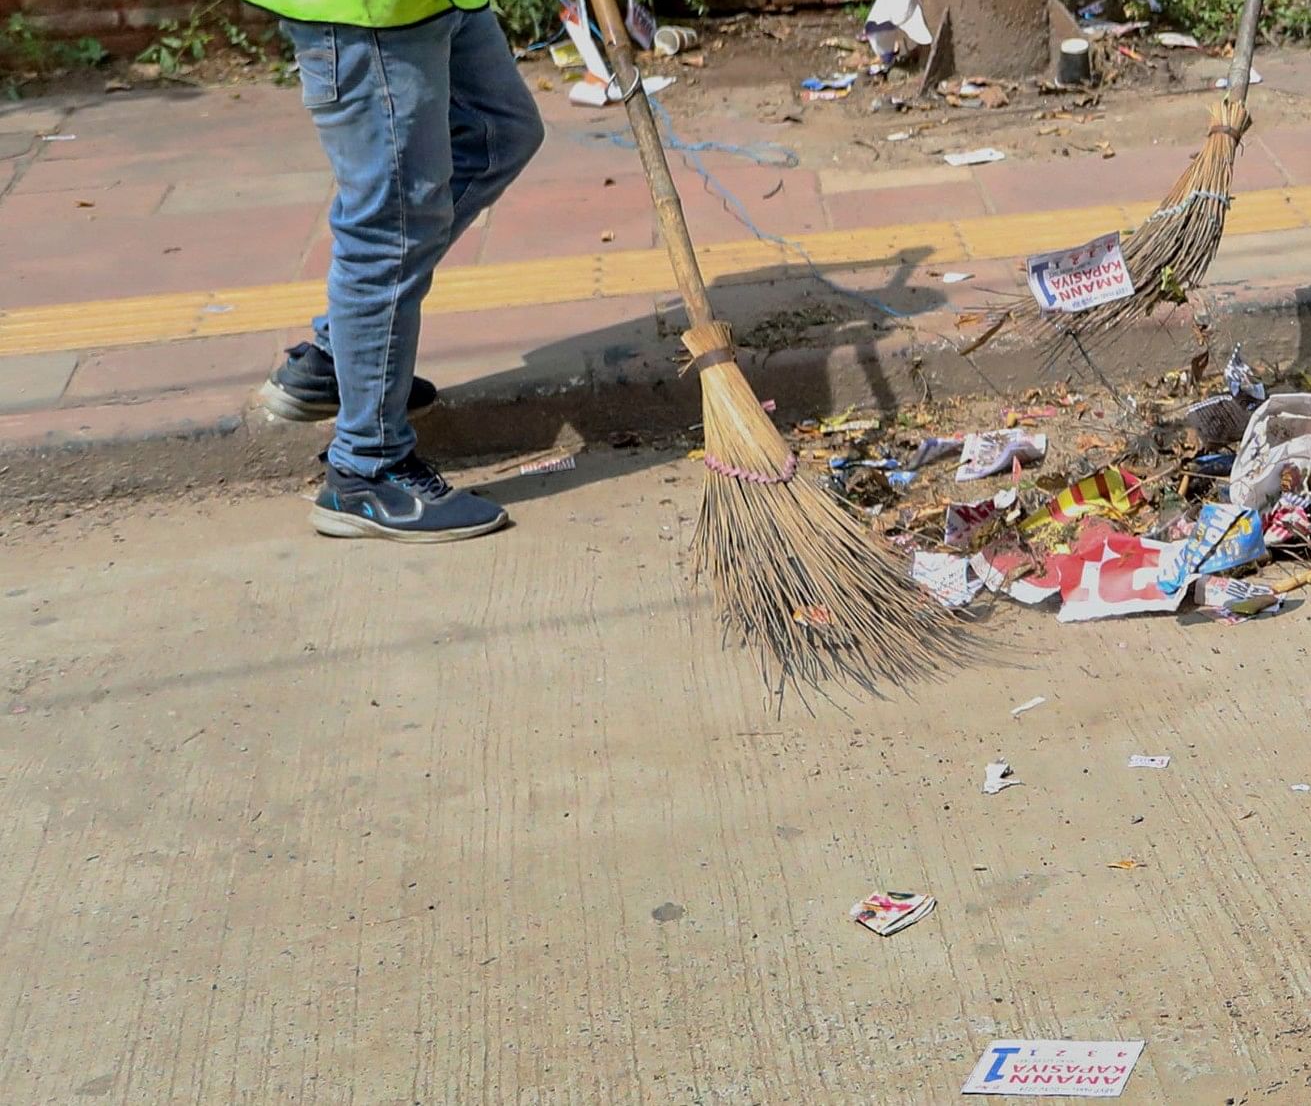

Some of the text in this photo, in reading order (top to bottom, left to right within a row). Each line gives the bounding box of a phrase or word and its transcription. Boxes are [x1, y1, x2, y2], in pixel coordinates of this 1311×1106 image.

[1031, 261, 1057, 308] 1
[1050, 260, 1122, 291] KAPASIYA
[1058, 272, 1125, 303] AMANN
[984, 1047, 1022, 1084] 1
[1009, 1074, 1121, 1085] AMANN
[1013, 1064, 1127, 1074] KAPASIYA
